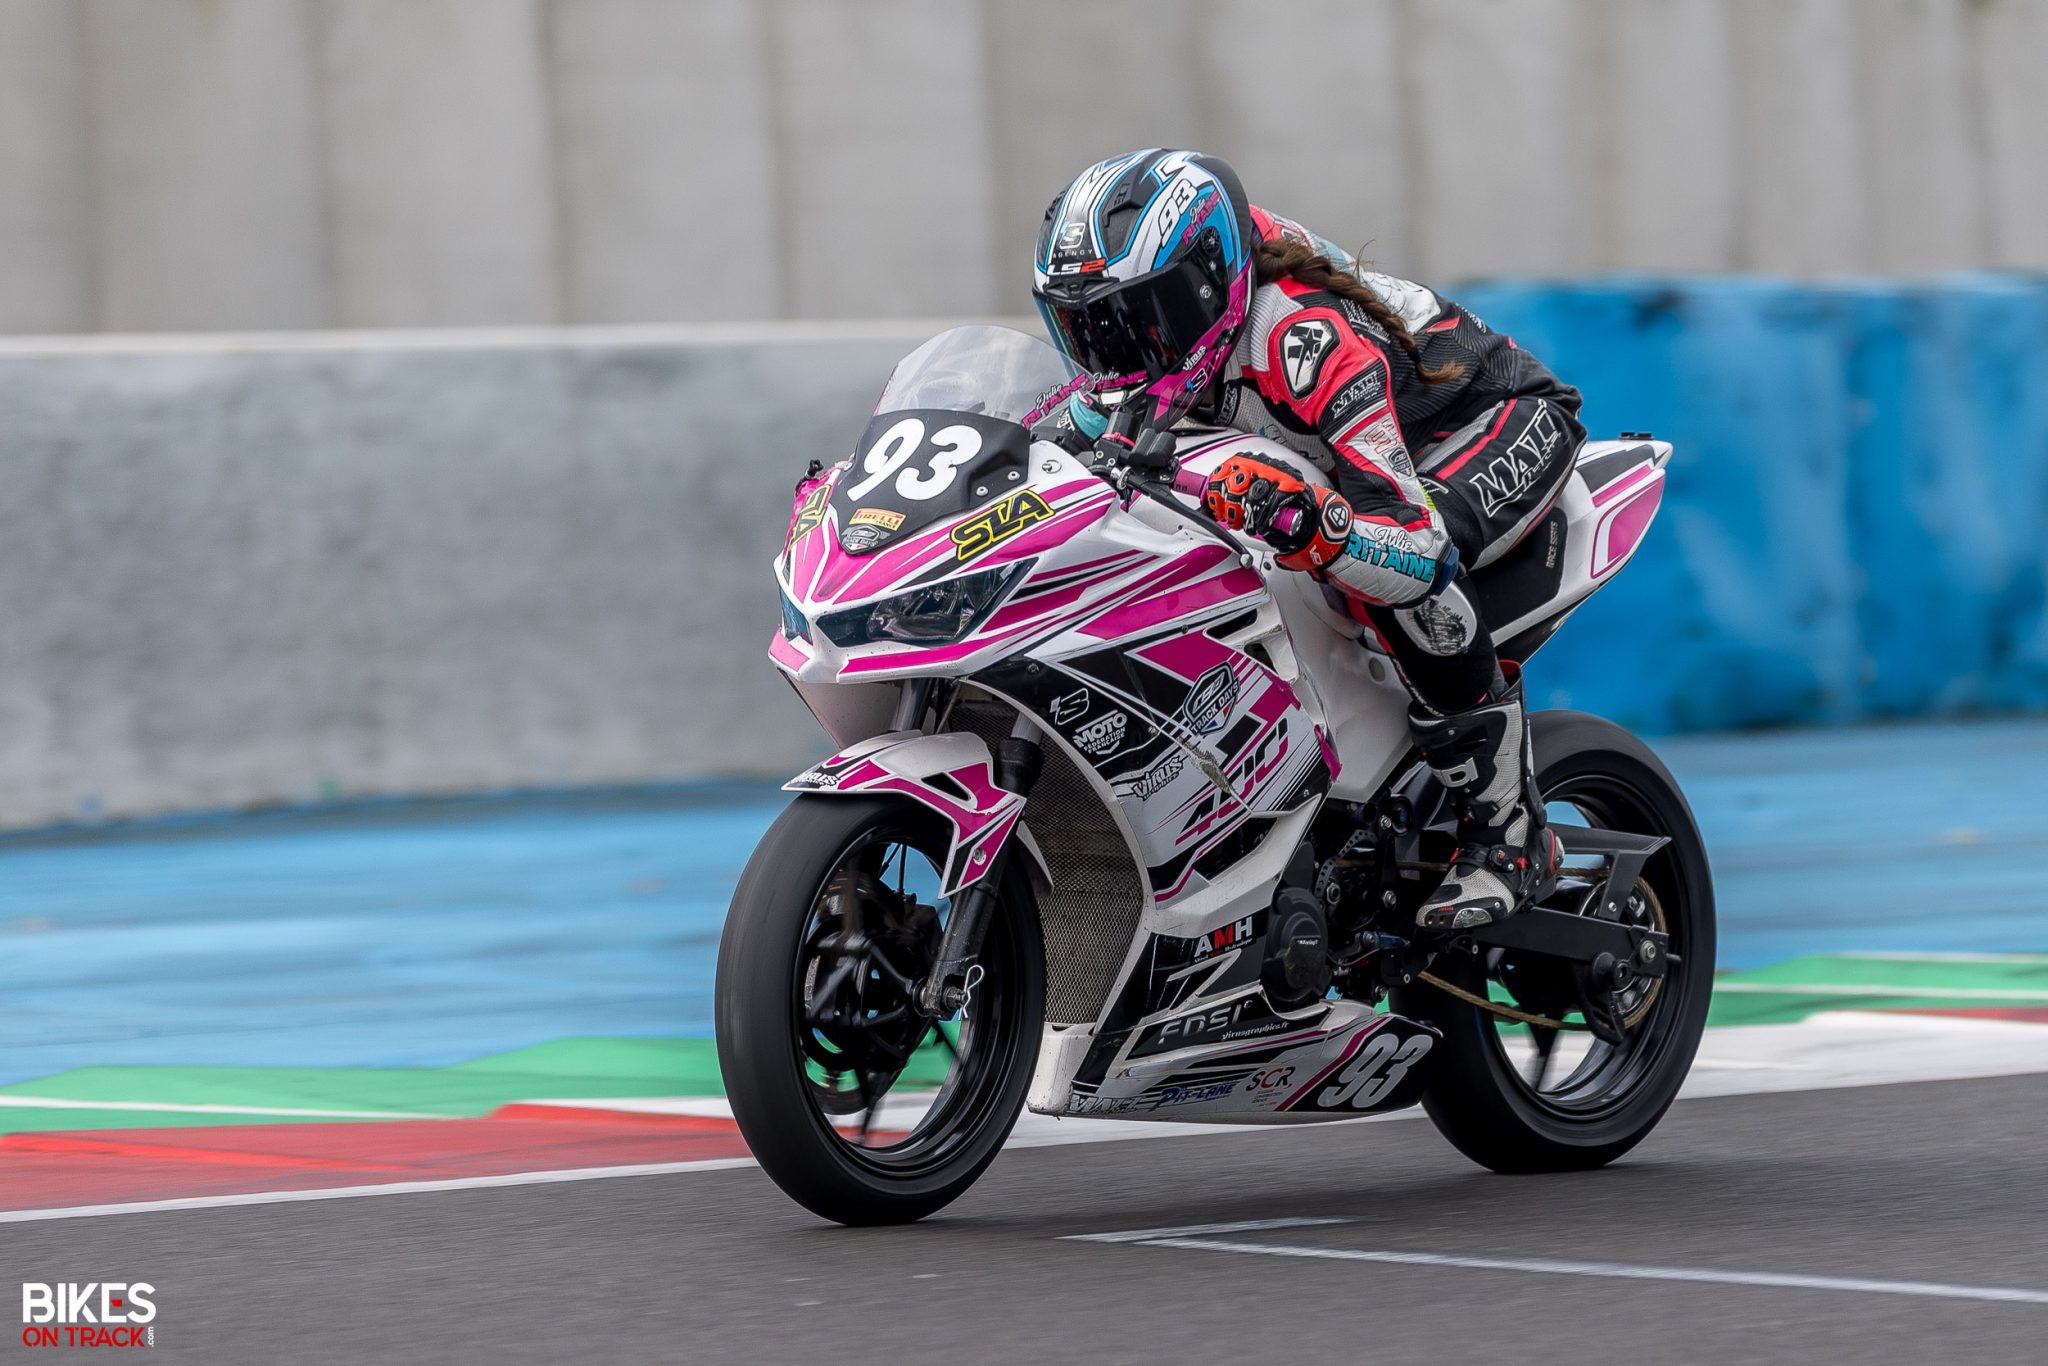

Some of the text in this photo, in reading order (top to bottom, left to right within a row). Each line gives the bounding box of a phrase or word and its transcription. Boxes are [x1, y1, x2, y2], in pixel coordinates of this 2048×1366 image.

[1158, 178, 1199, 249] 93
[1046, 258, 1107, 276] LS2
[1052, 248, 1093, 259] AGENCY
[847, 418, 982, 501] 93
[853, 509, 903, 527] PIRELLI
[949, 489, 1055, 561] SLA
[1374, 526, 1413, 552] Julie
[1346, 532, 1437, 583] RITAINE
[1072, 712, 1128, 749] MOTO
[1190, 703, 1219, 734] TRACK
[1218, 681, 1239, 708] DAYS
[1193, 916, 1253, 958] AMH
[1317, 1033, 1433, 1108] 93
